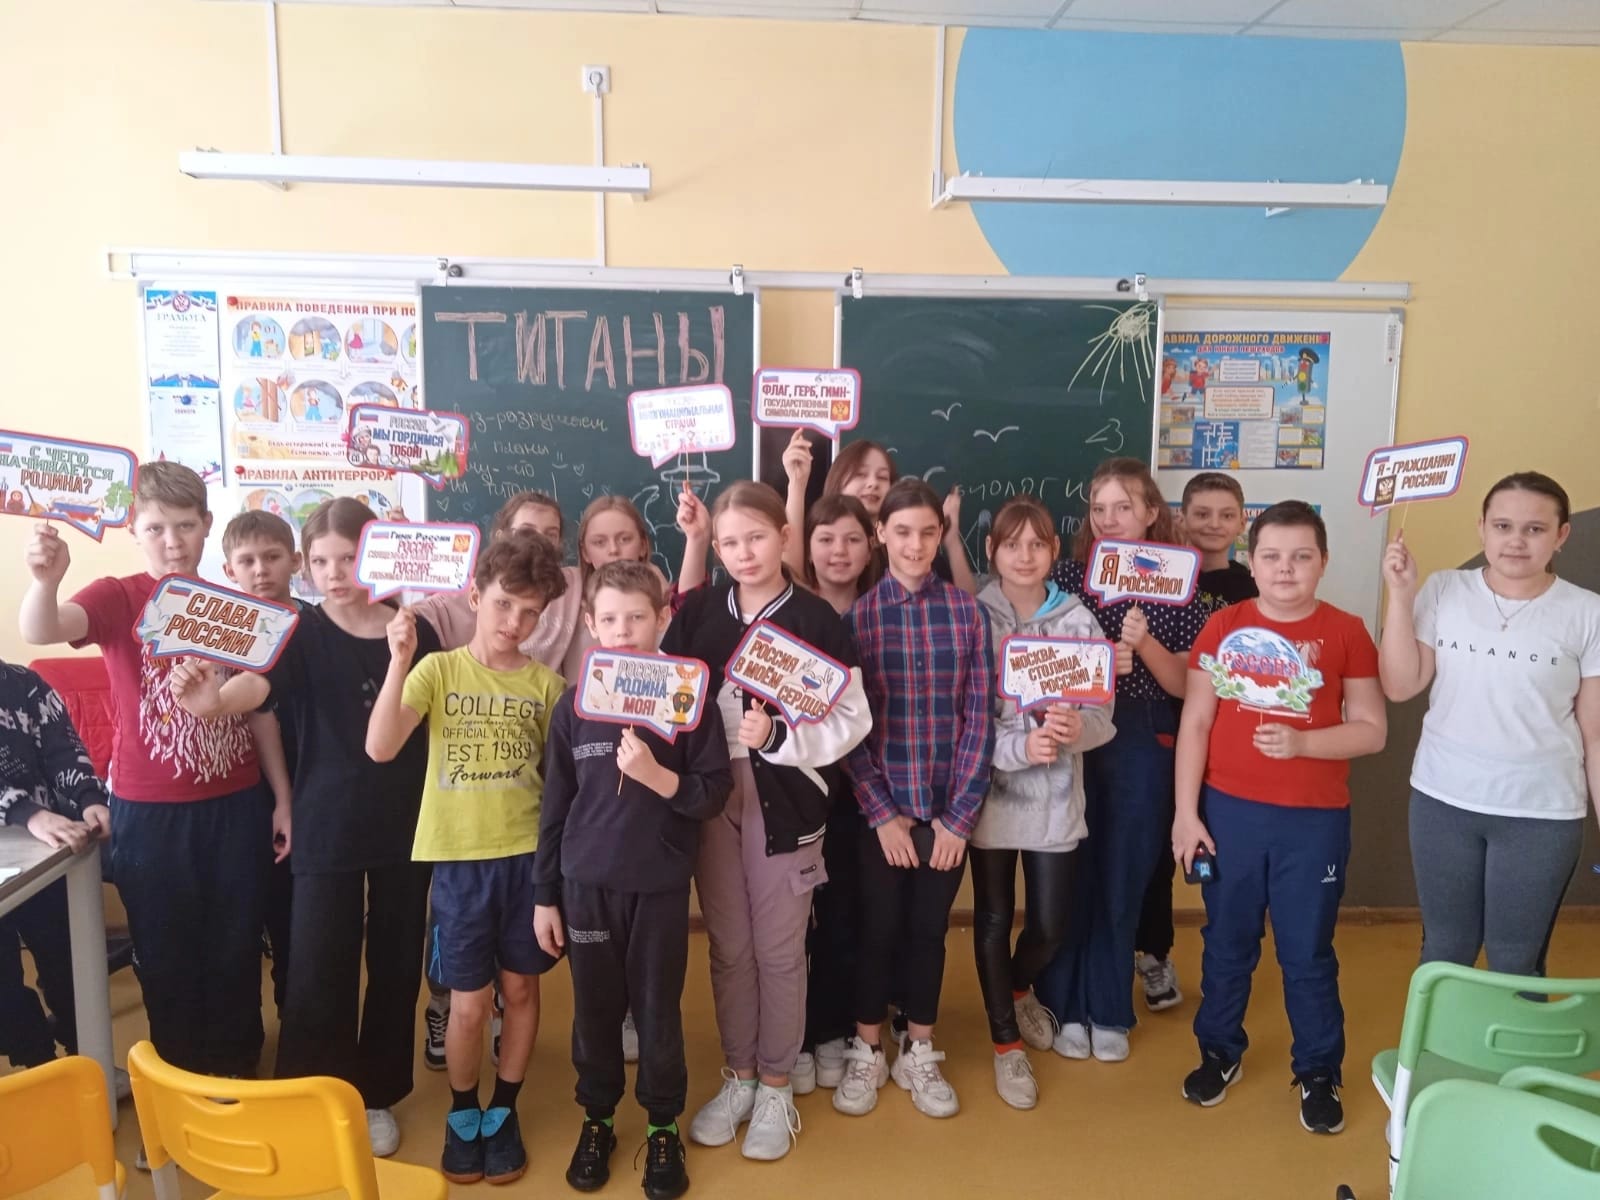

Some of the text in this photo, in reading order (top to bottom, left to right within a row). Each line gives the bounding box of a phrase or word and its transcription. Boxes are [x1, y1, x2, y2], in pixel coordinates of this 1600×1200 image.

[236, 302, 292, 312] ПРАВИЛА
[296, 303, 369, 315] ПОВЕДЕНИЯ
[373, 306, 397, 316] ПРИ
[434, 306, 725, 391] ТИТАНЫ
[1203, 333, 1270, 345] ДОРОЖНОГО
[1272, 333, 1322, 345] ДВИЖЕН
[762, 384, 792, 398] ФЛАГ,
[793, 385, 818, 399] ГЕРБ,
[372, 428, 444, 448] МЫ ГОРДИМСЯ
[29, 445, 89, 465] С ЧЕГО
[388, 443, 423, 459] ТОБОЙ!
[239, 469, 393, 481] ПРАВИЛА АНТИТЕРРОРА
[1376, 463, 1386, 477] Я
[1392, 453, 1456, 474] ГРАЖДАНИН
[20, 468, 93, 495] РОДИНА?
[1400, 470, 1448, 490] РОССИИ!
[415, 532, 451, 542] России
[1099, 554, 1184, 596] Я РОССИЮ!
[186, 592, 260, 632] СЛАВА
[164, 614, 257, 657] РОССИИ!
[748, 639, 800, 674] РОССИЯ
[1009, 646, 1060, 673] МОСКВА-
[1222, 651, 1301, 678] РОССИЯ
[1437, 639, 1558, 666] BALANCE
[733, 655, 784, 690] В МОЁМ
[1027, 654, 1082, 682] СТОЛИЦА
[1039, 667, 1091, 696] РОССИИ!
[622, 696, 657, 717] МОЯ!
[442, 726, 489, 740] OFFICIAL
[449, 763, 526, 784] Forward
